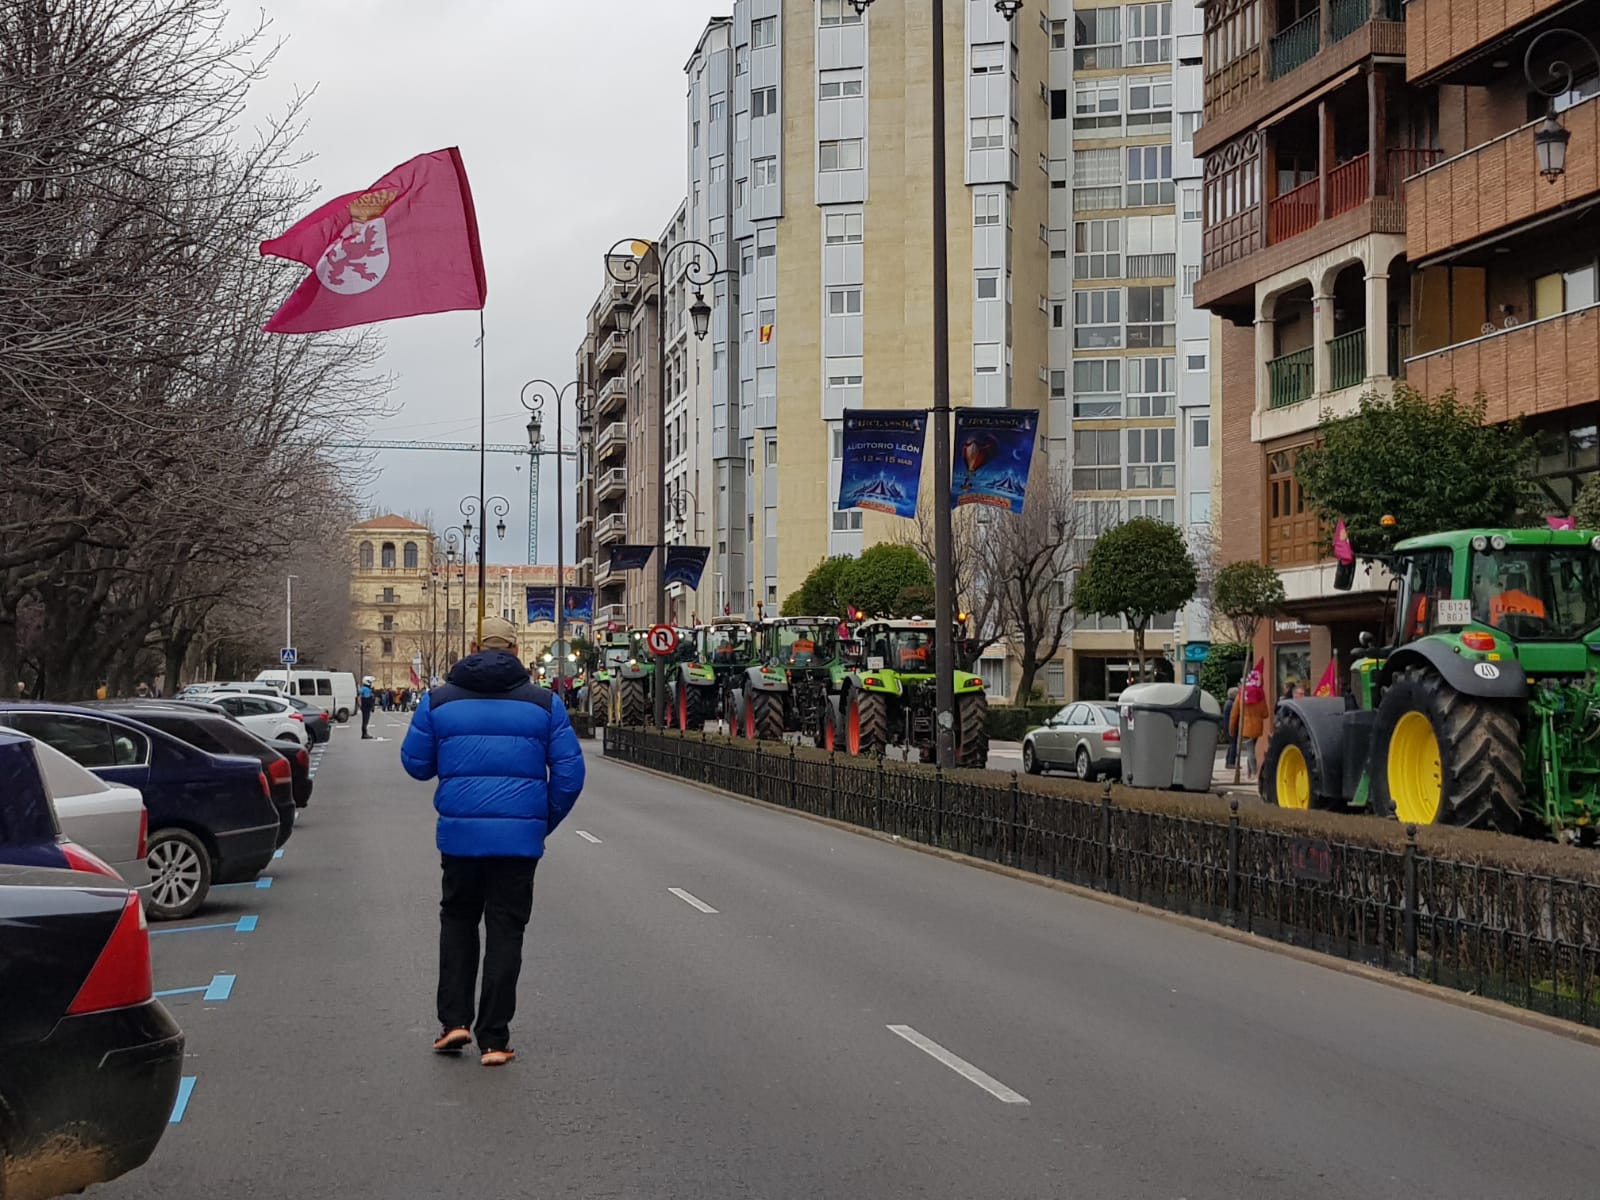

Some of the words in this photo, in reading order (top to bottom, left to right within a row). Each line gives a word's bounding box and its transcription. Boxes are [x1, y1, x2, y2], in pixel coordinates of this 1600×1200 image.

[847, 442, 894, 450] AUDITORIO
[895, 443, 920, 454] LEÓN
[1481, 665, 1496, 677] 40
